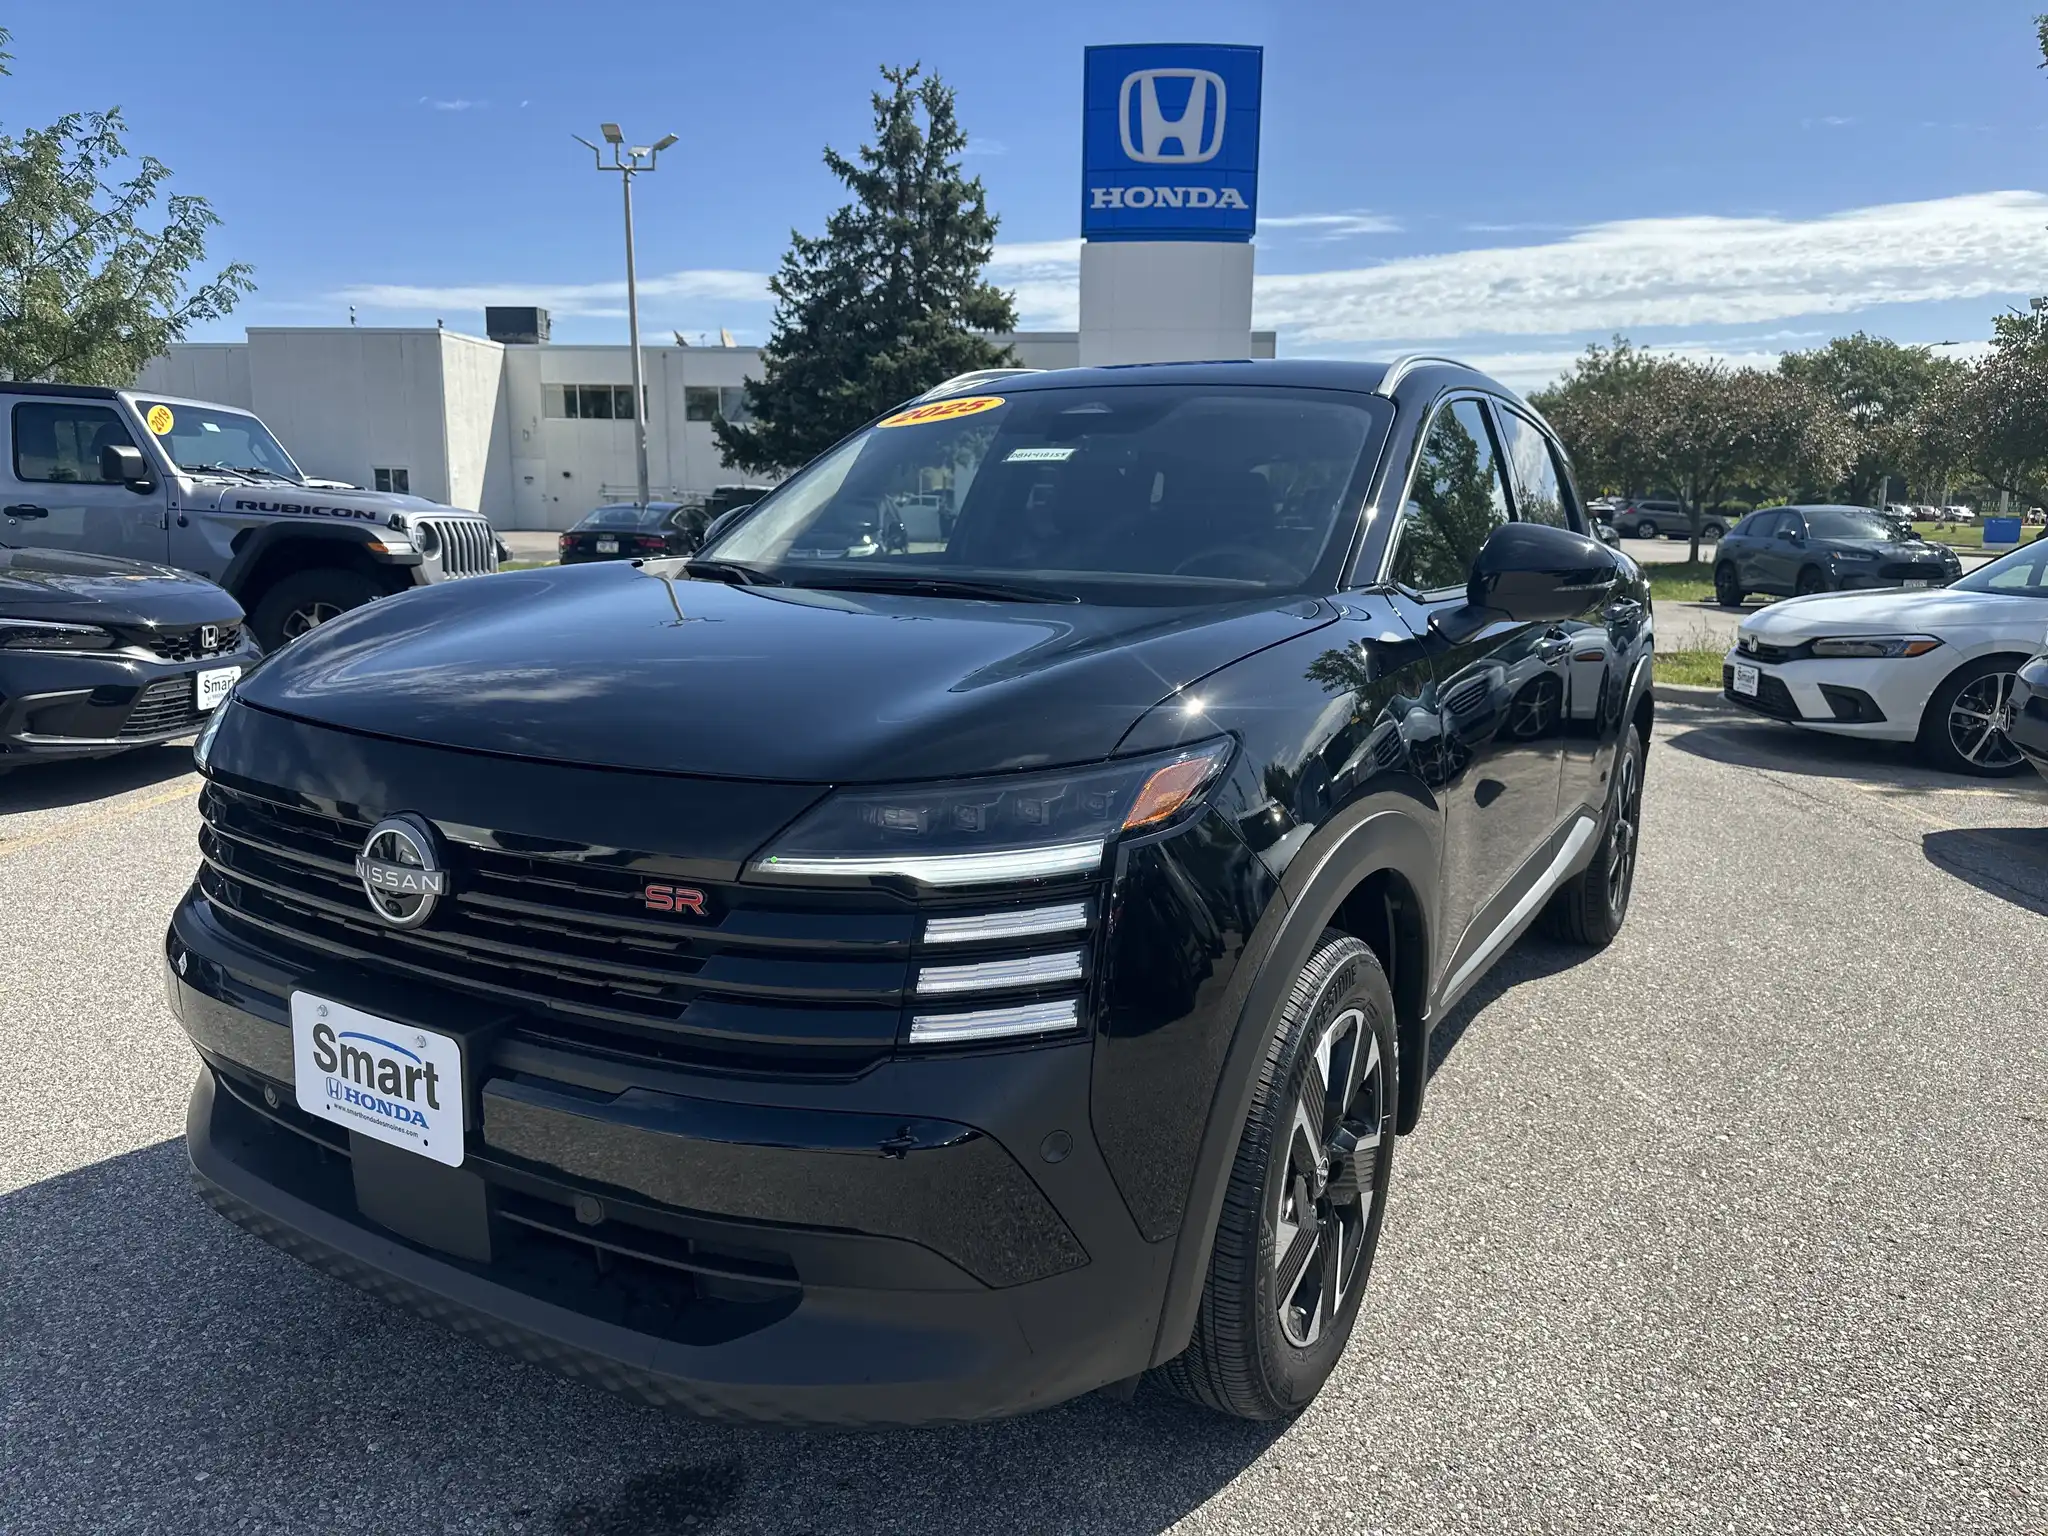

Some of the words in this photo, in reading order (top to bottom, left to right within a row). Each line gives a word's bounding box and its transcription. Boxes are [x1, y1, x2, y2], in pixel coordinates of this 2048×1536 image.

[1090, 186, 1249, 209] HONDA
[151, 408, 170, 432] 2019
[887, 398, 996, 425] 2025
[235, 500, 376, 520] RUBICON
[204, 675, 235, 694] Smart
[355, 859, 440, 892] NISSAN
[645, 885, 706, 915] SR
[312, 1023, 440, 1111] Smart
[333, 1103, 419, 1139] www.smarthondadesmoines.com
[344, 1086, 430, 1130] HONDA
